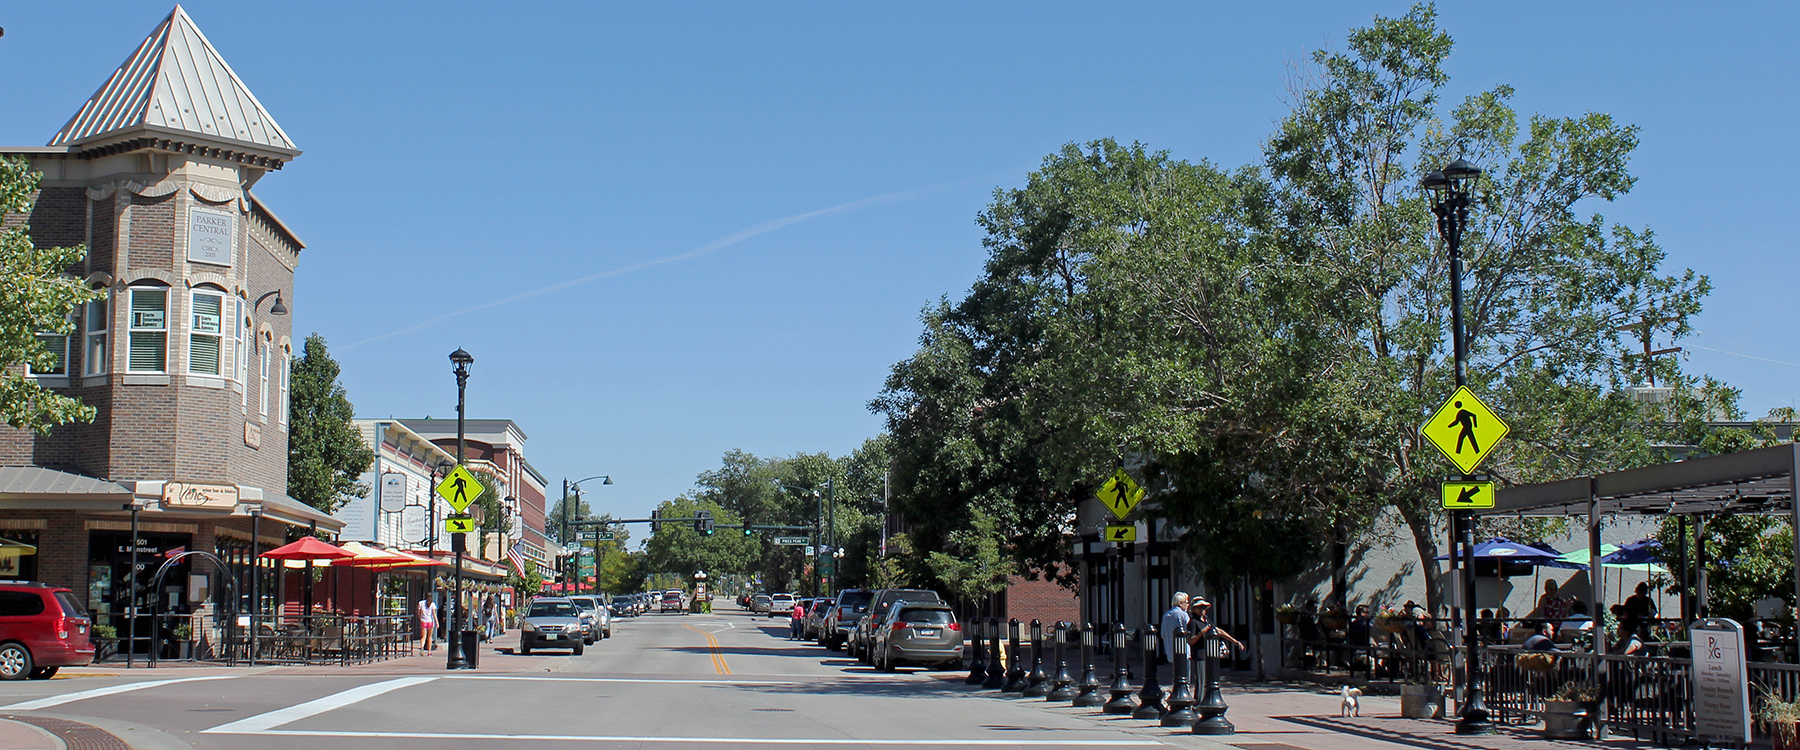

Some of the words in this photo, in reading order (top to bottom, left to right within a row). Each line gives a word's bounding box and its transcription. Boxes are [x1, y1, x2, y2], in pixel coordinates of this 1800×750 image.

[196, 216, 227, 226] PARKER
[193, 224, 230, 236] CENTRAL
[1704, 701, 1718, 710] Happy
